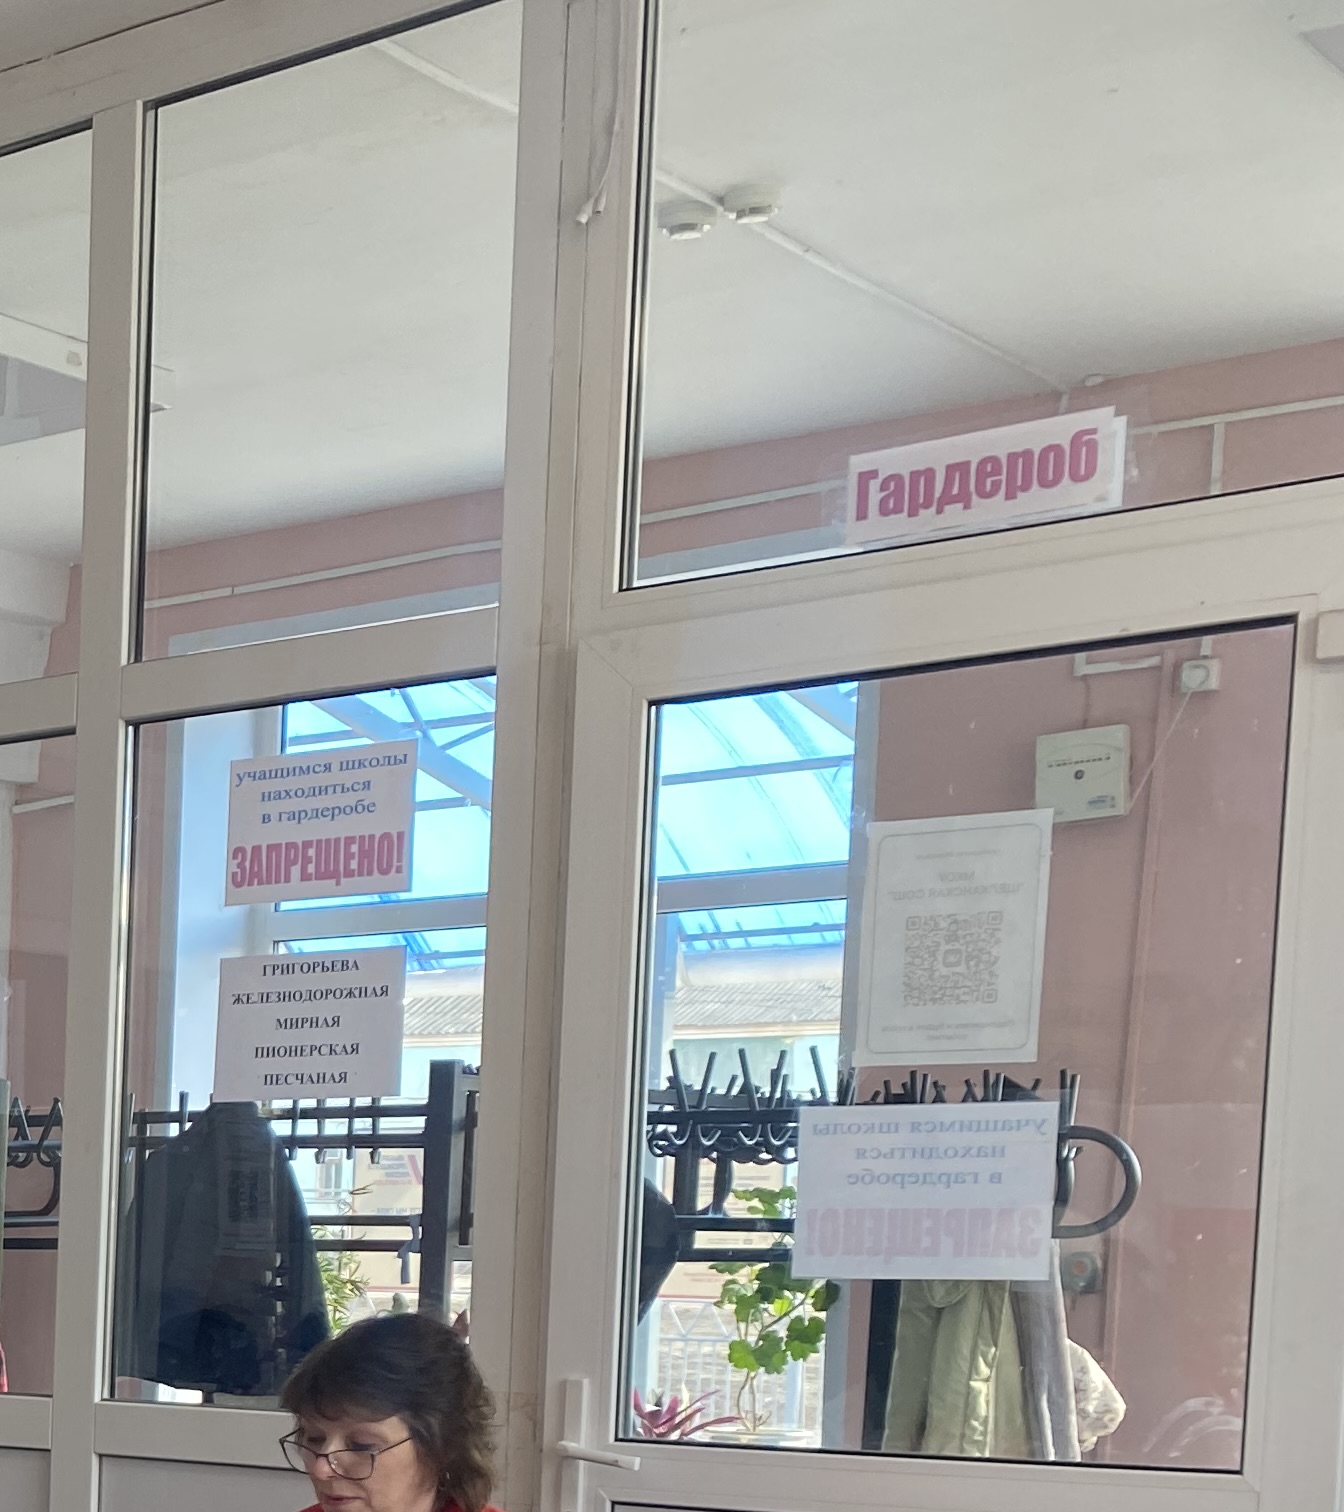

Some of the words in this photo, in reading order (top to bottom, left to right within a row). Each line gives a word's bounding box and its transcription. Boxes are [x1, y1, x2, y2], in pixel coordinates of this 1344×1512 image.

[855, 427, 1099, 522] Гардероб
[235, 759, 333, 787] учащимся
[338, 752, 409, 774] школы
[260, 777, 372, 803] находиться
[261, 812, 272, 825] в
[277, 798, 377, 825] гардеробе
[231, 831, 406, 888] ЗАПРЕЩЕНО!
[262, 958, 360, 977] ГРИГОРЬЕВА
[232, 984, 390, 1006] ЖЕЛЕЗНОДОРОЖНАЯ
[275, 1014, 341, 1031] МИРНАЯ
[254, 1042, 360, 1060] ПИОНЕРСКАЯ
[263, 1070, 348, 1087] ПЕСЧАНАЯ
